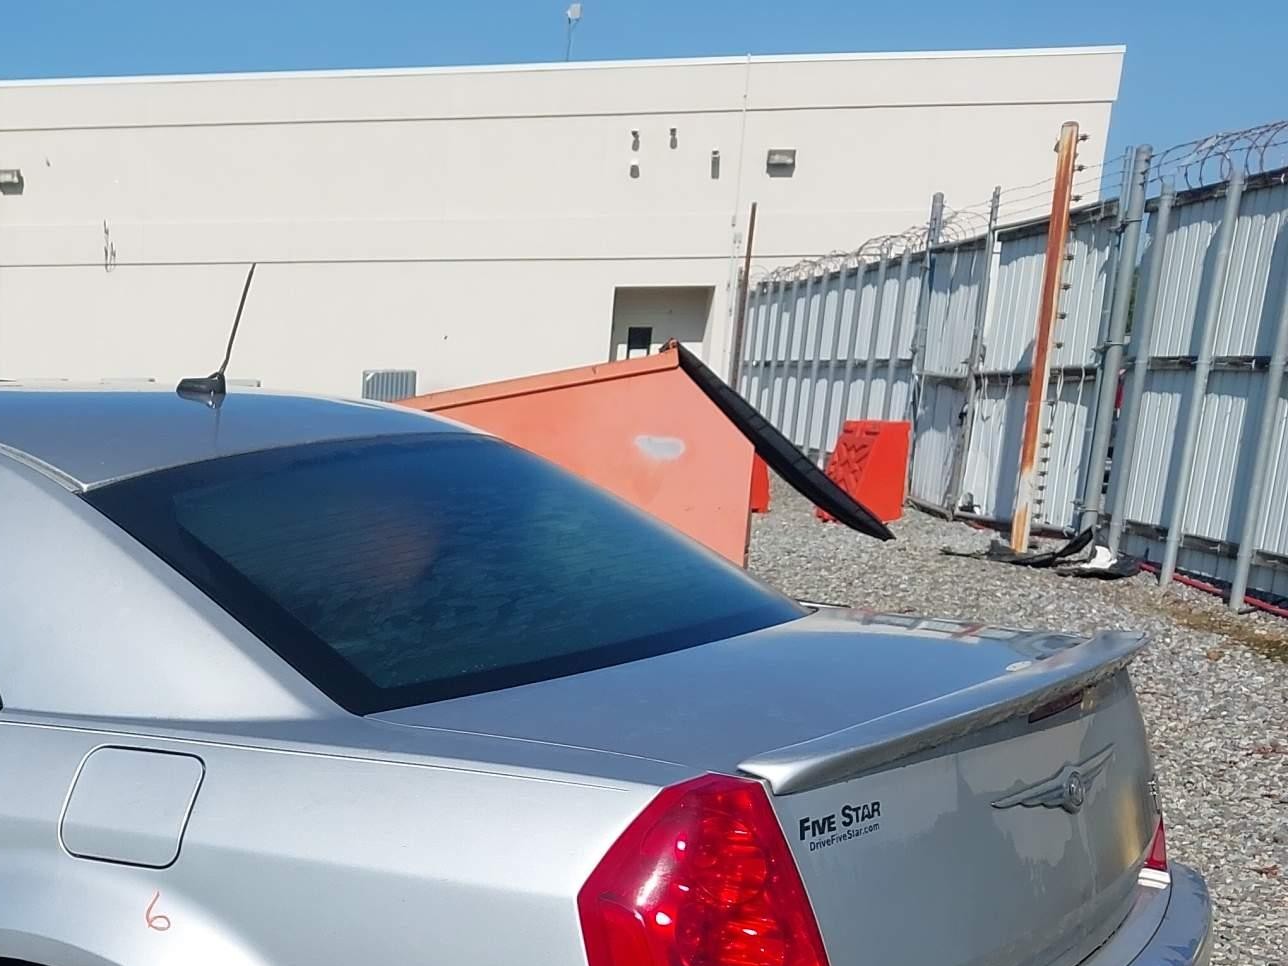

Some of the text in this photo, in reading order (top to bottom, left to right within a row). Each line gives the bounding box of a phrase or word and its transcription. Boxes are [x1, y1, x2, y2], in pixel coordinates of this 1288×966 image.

[799, 801, 881, 841] FIVE STAR
[809, 823, 881, 852] DriveFiveStar.com
[145, 890, 171, 931] 6
